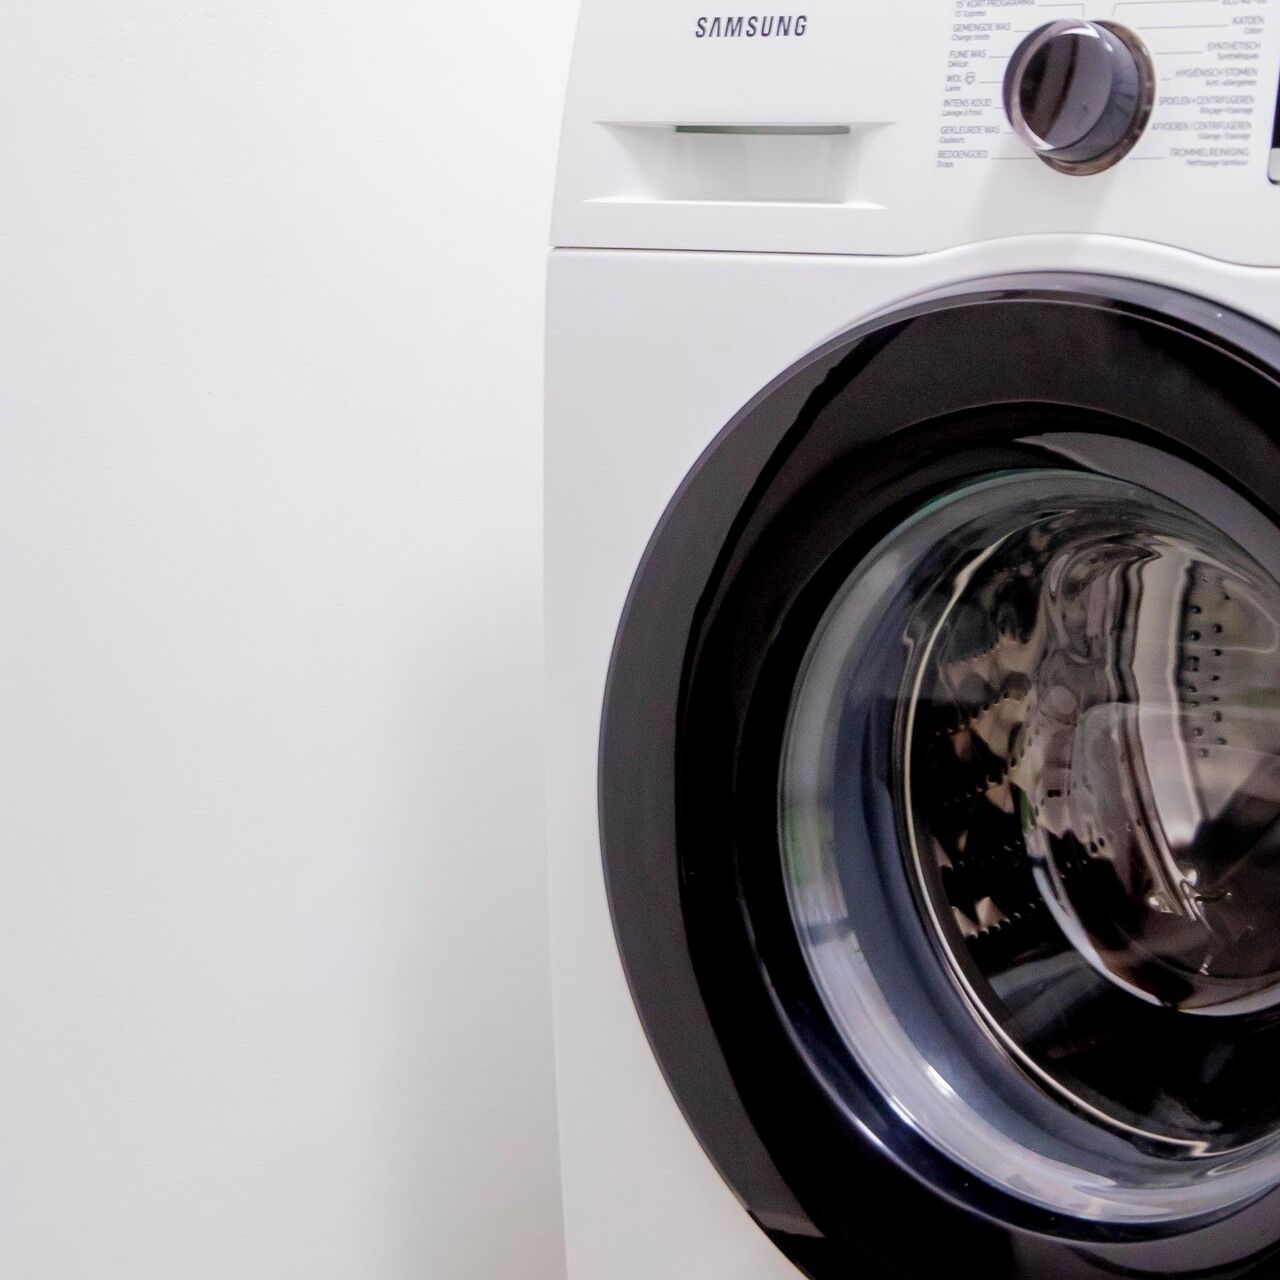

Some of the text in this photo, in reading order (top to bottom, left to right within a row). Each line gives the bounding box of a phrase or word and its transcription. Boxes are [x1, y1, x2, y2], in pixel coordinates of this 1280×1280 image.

[695, 15, 808, 39] SAMSUNG
[946, 74, 962, 82] WOL
[943, 98, 992, 107] INTENS KOUD
[937, 150, 989, 159] BEDDENGOED
